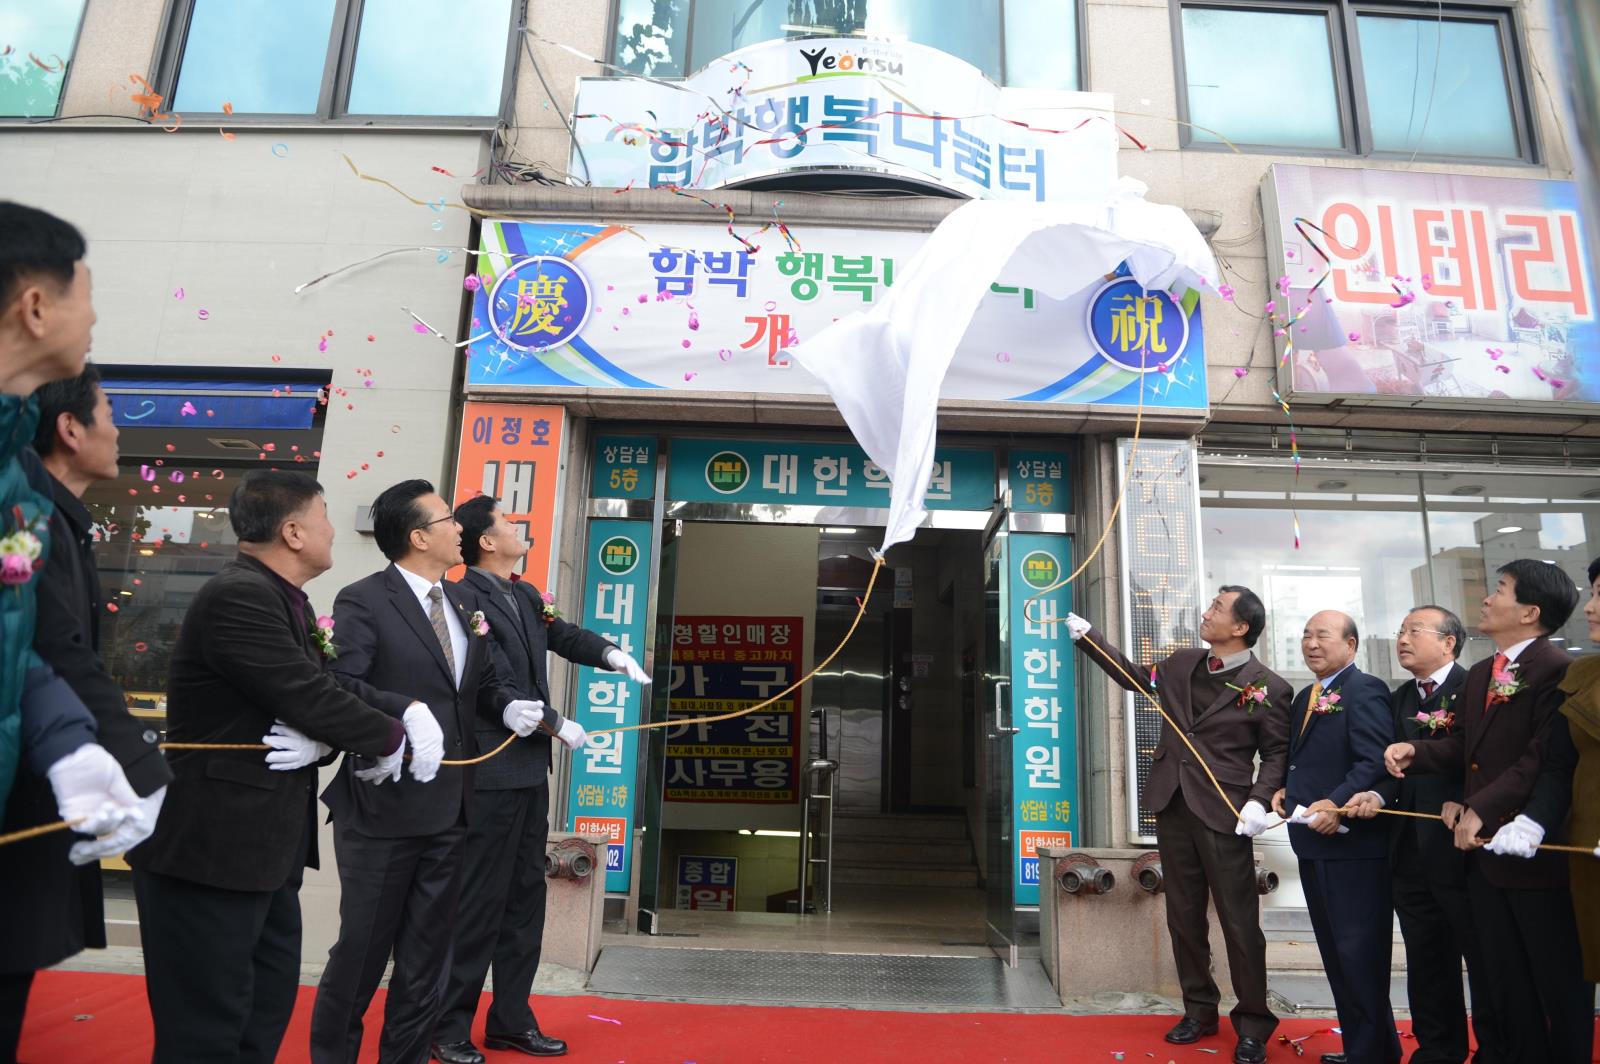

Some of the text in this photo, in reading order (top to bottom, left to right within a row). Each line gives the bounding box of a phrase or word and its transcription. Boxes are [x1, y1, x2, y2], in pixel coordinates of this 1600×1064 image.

[800, 47, 903, 77] Yeonsu
[649, 94, 1045, 202] 함박행복나눔터
[649, 248, 756, 298] 함박
[1322, 203, 1588, 317] 인테리
[516, 274, 568, 337] 慶
[1110, 294, 1168, 353] 祝
[473, 416, 550, 446] 이정호
[603, 446, 649, 464] 상담실
[1017, 460, 1062, 479] 상담실
[609, 468, 640, 492] 5층
[1025, 482, 1056, 507] 5층
[1024, 599, 1063, 789] 대한학원
[668, 759, 789, 788] 사무용
[606, 849, 619, 867] 02
